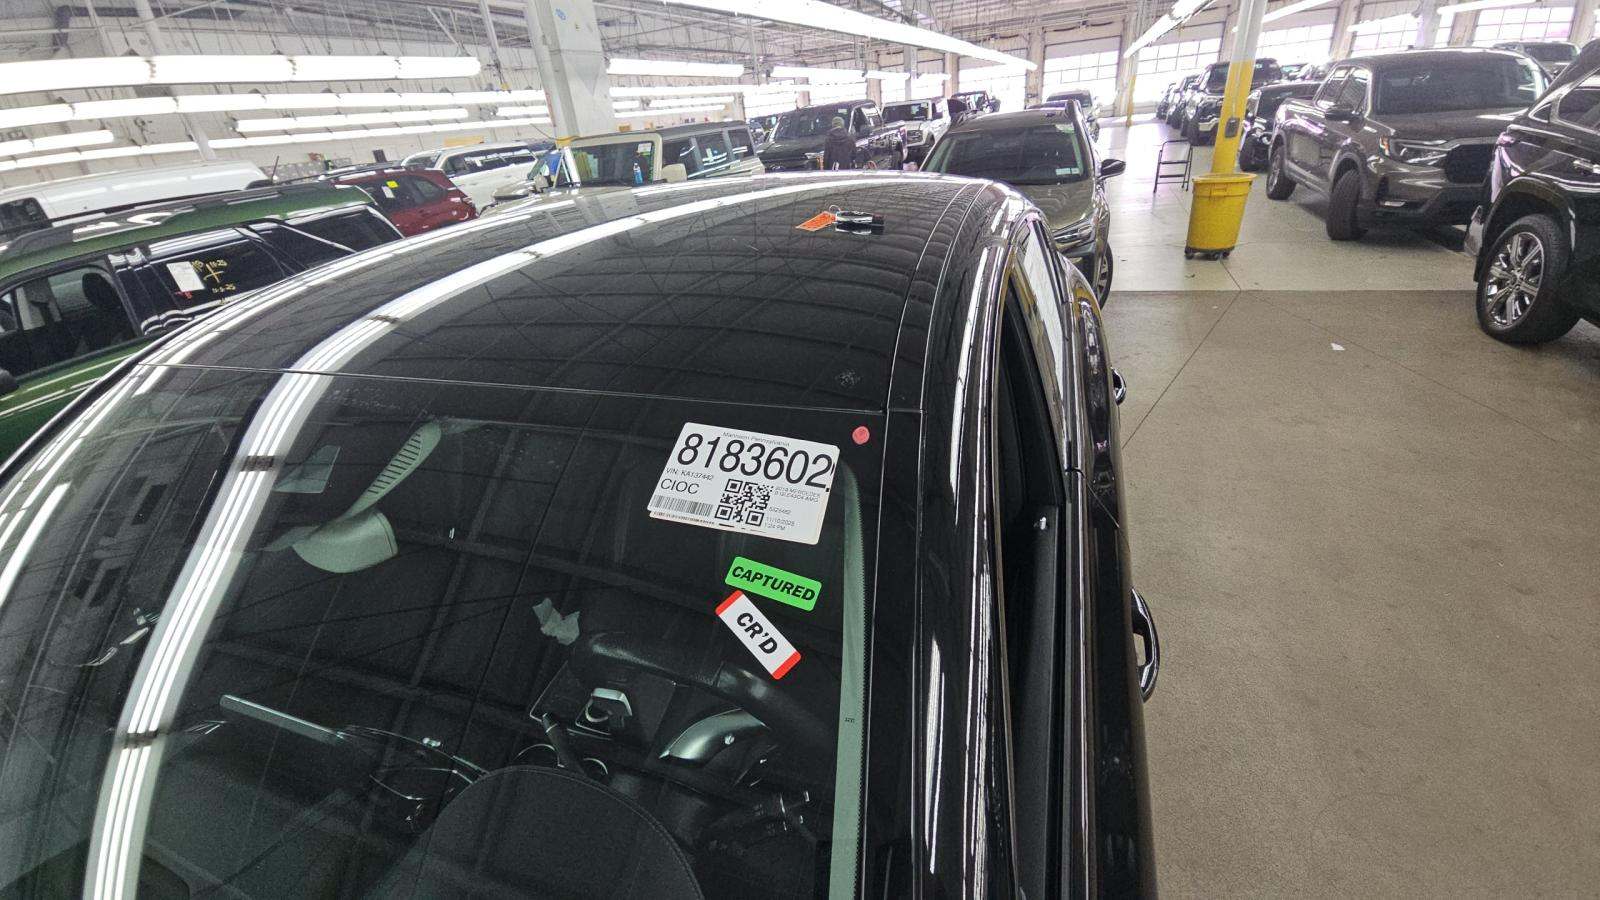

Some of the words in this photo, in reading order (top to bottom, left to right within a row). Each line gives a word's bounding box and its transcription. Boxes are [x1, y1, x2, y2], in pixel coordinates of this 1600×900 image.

[677, 433, 832, 489] 8183602
[660, 478, 700, 495] CIOC
[681, 470, 714, 480] KA137442
[732, 566, 816, 601] CAPTURED
